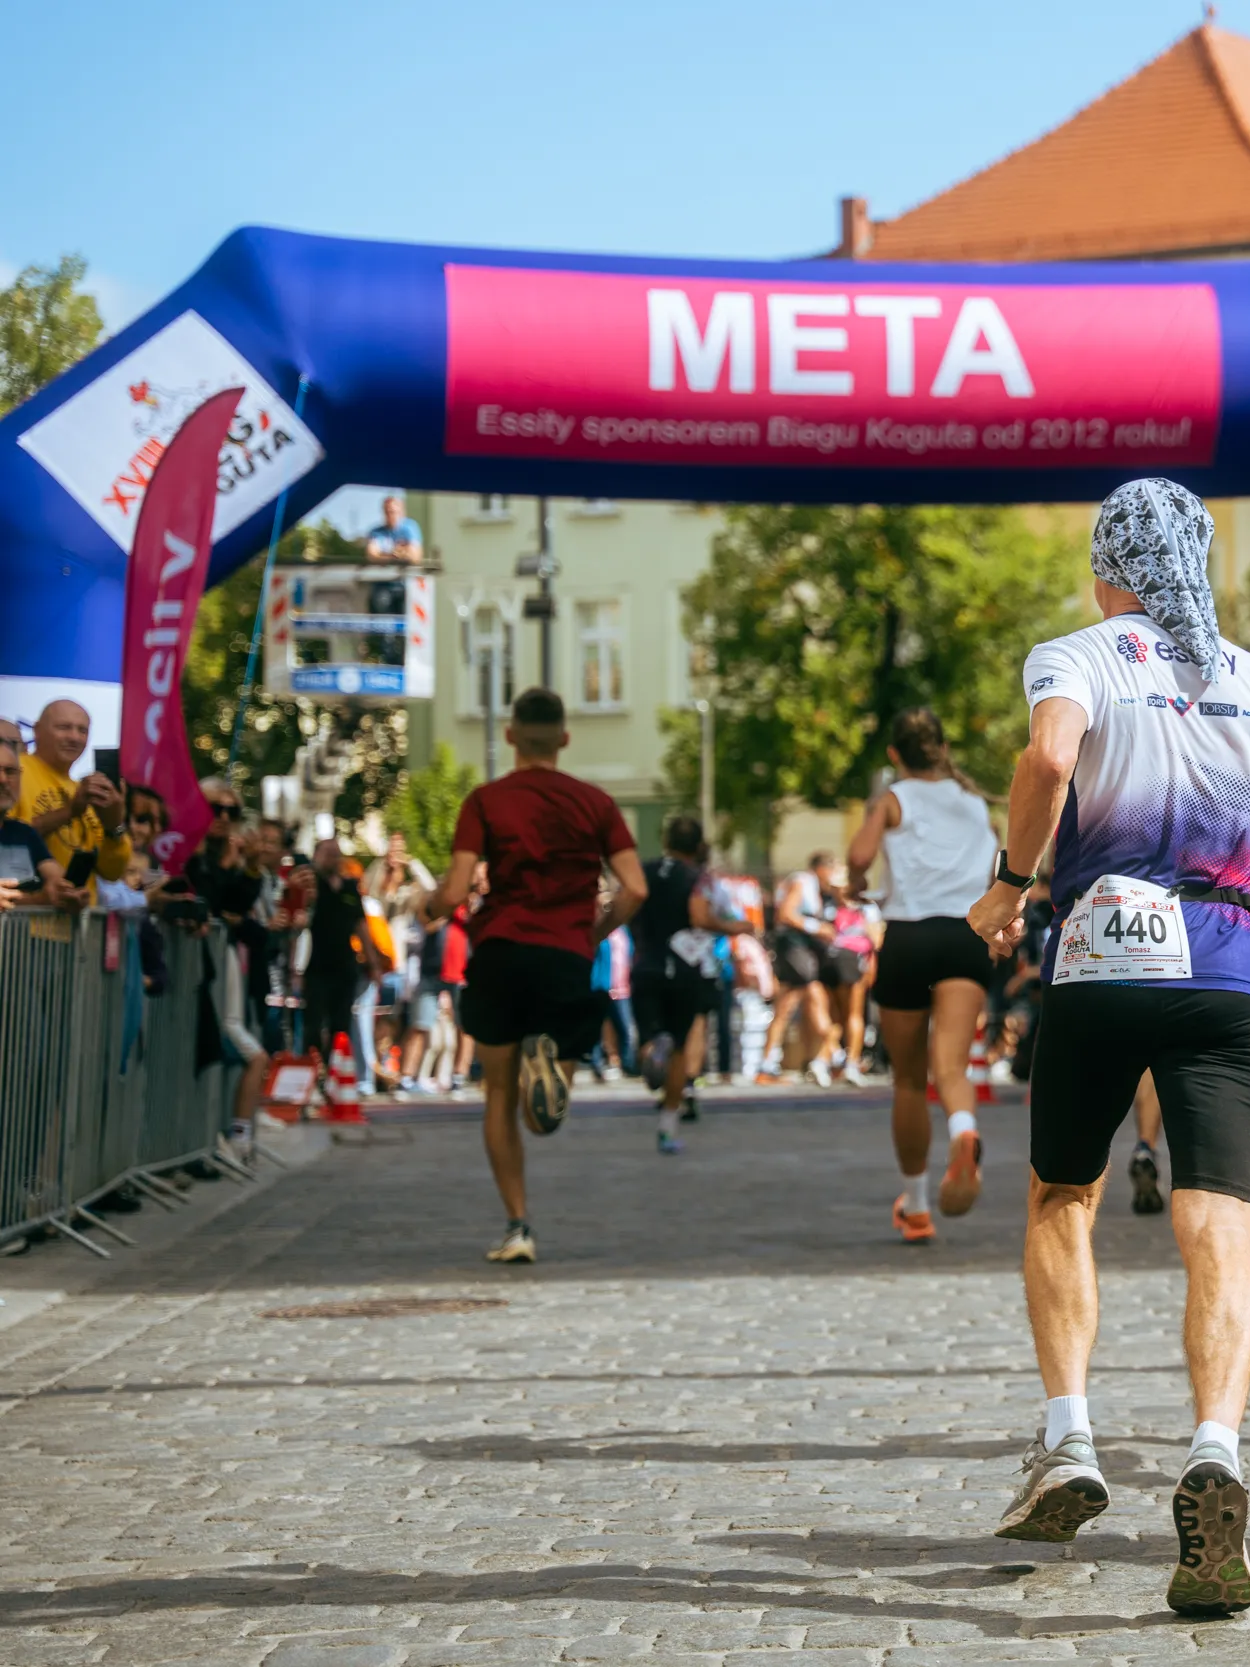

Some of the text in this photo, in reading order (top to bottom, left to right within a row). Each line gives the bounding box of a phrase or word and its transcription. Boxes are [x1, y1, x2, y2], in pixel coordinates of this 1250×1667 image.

[647, 288, 1036, 399] META
[476, 403, 576, 445] Essity
[581, 415, 760, 447] sponsorem
[767, 416, 859, 453] Biegu
[865, 416, 977, 454] Koguta
[982, 417, 1025, 448] od
[1029, 418, 1109, 449] 2012
[1154, 641, 1236, 676] esy
[1147, 697, 1166, 707] TORK
[1202, 702, 1231, 715] JOBST
[1103, 909, 1167, 944] 440
[1124, 946, 1151, 954] Tomasz
